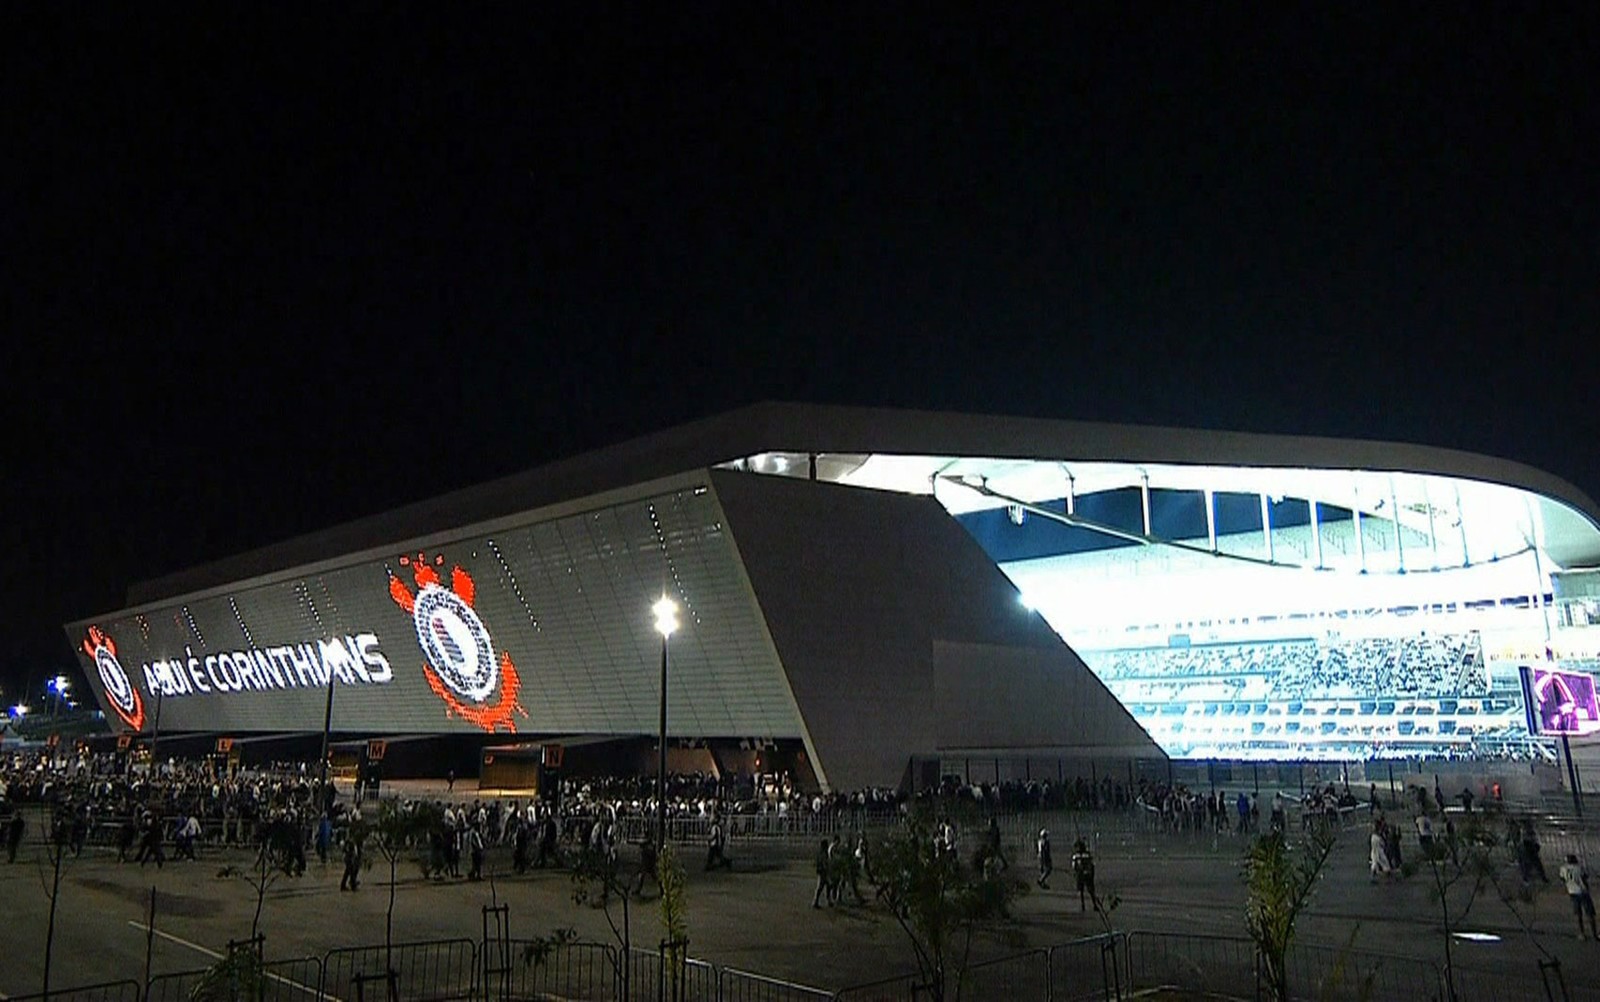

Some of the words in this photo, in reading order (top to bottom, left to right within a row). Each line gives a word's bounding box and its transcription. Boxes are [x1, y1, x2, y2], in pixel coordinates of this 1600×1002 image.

[186, 646, 211, 692] É
[205, 632, 394, 693] CORINTHIANS
[371, 742, 383, 758] M
